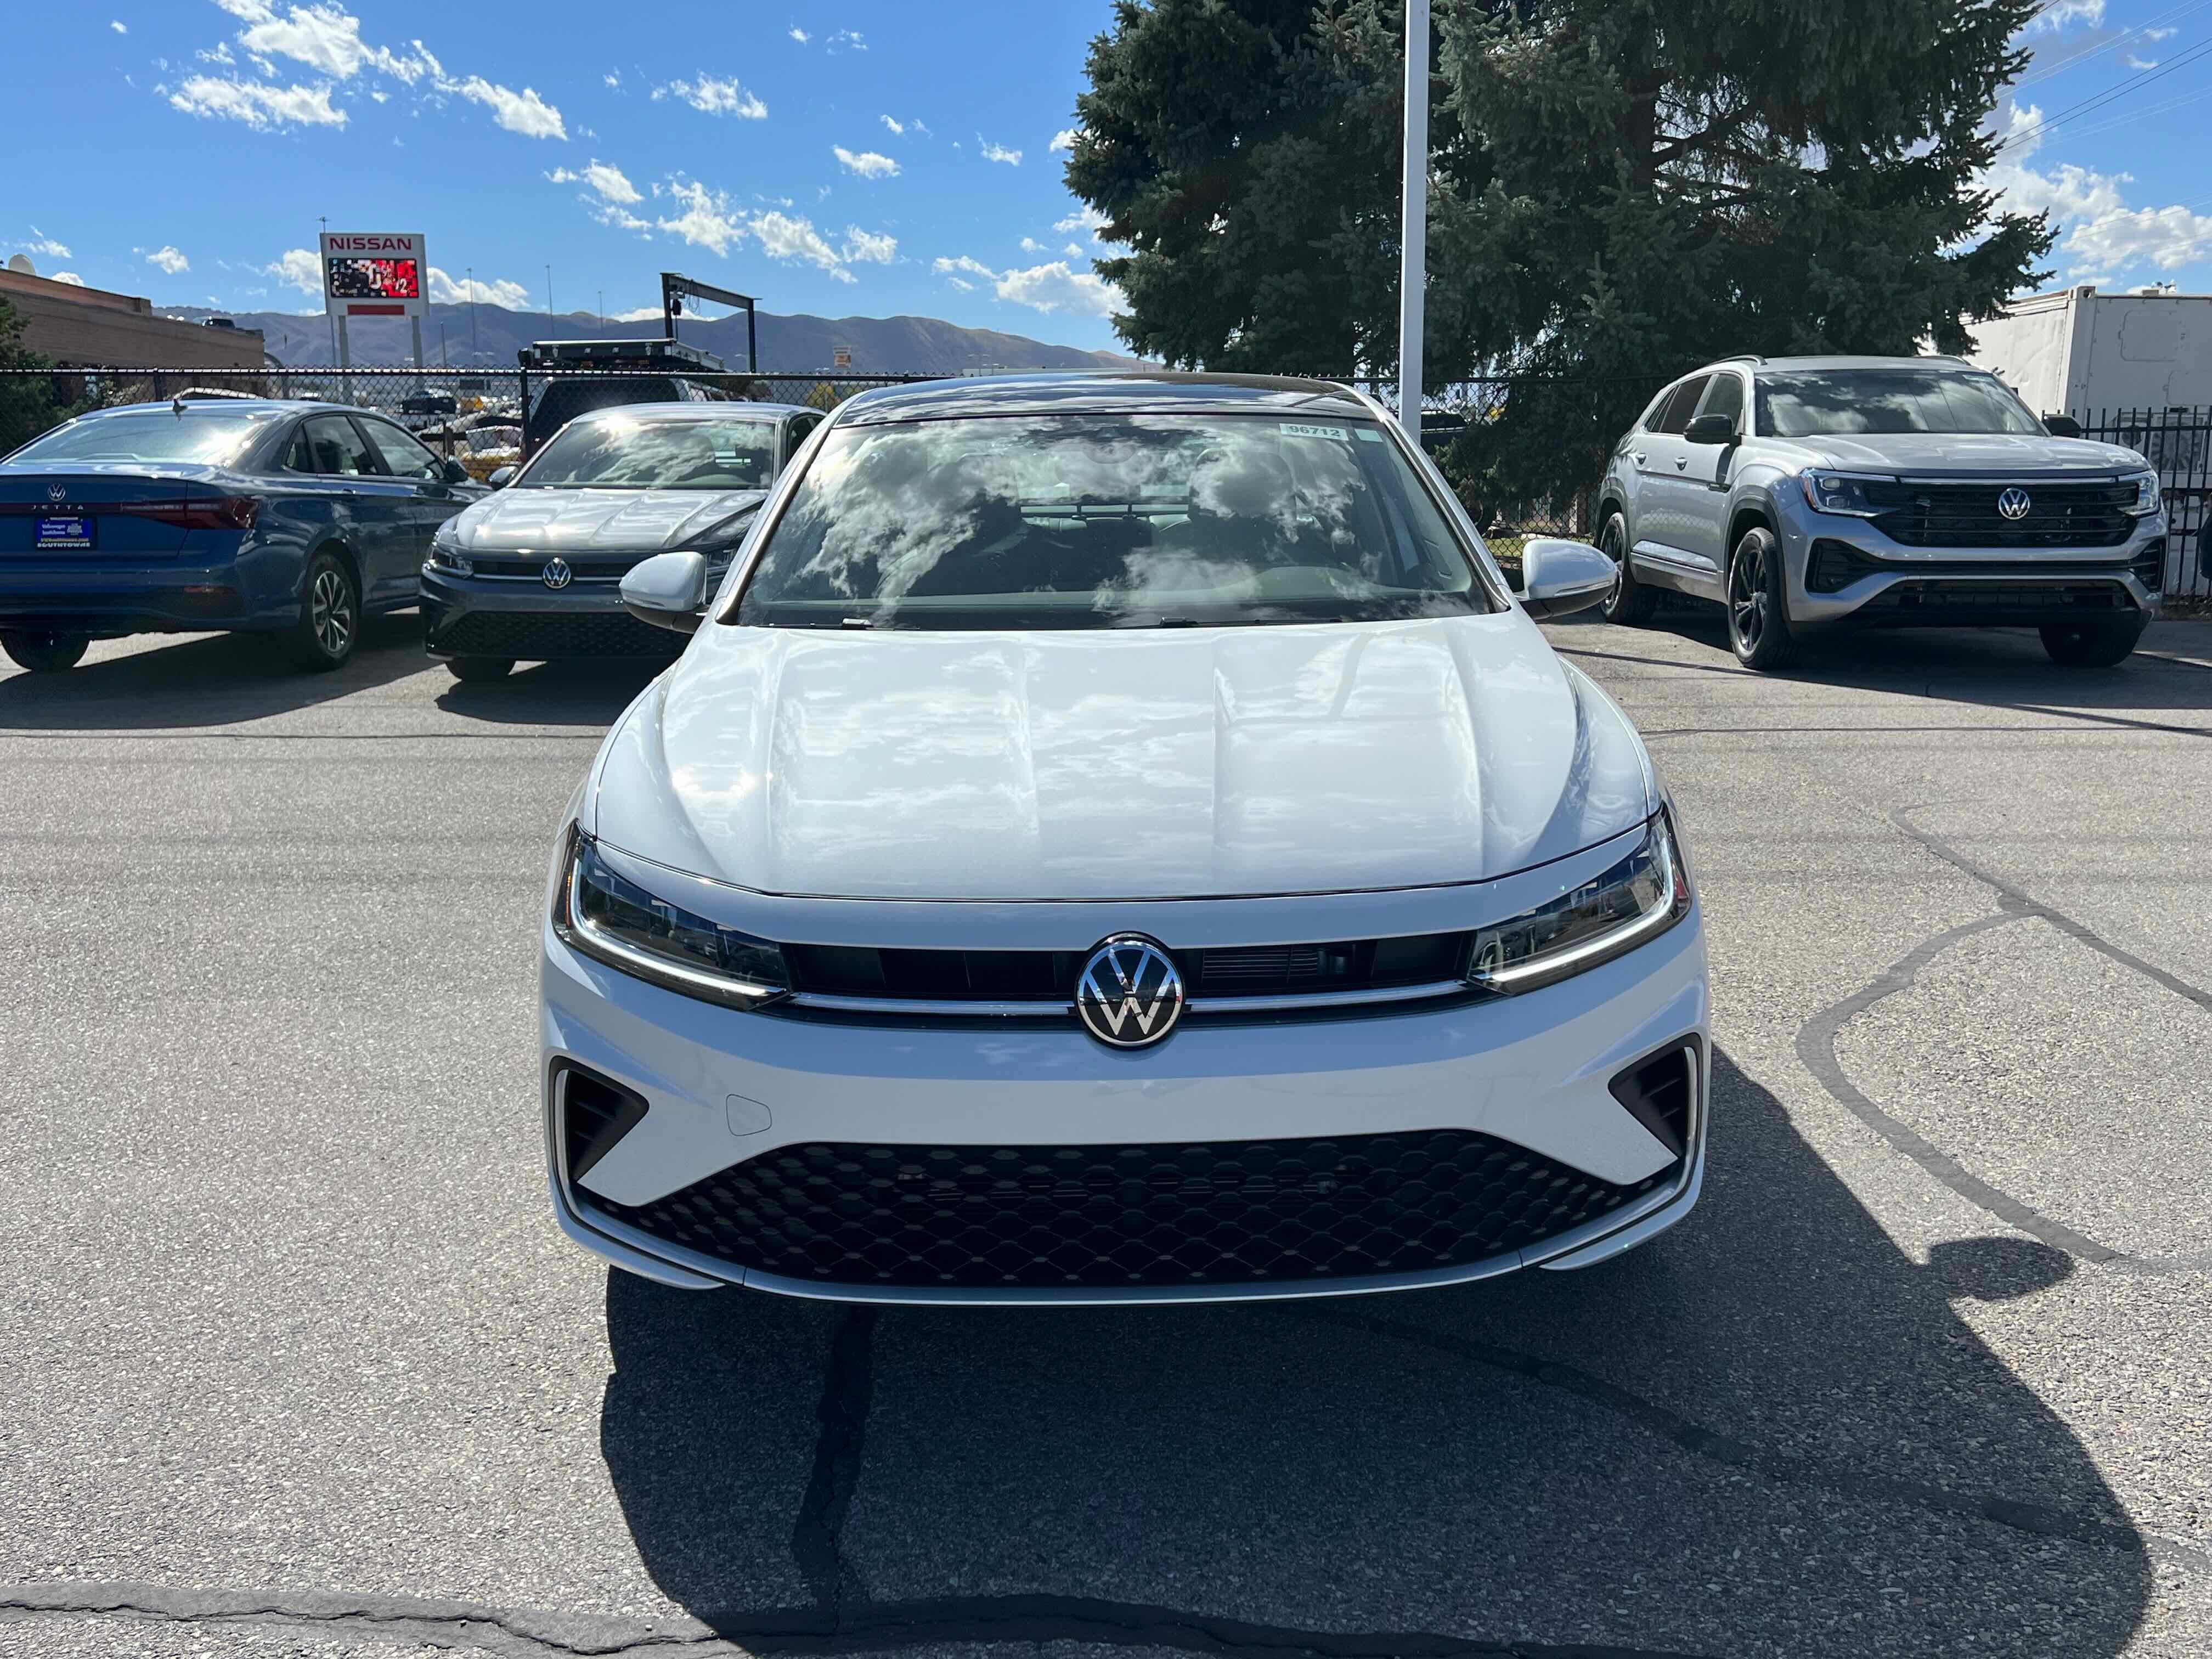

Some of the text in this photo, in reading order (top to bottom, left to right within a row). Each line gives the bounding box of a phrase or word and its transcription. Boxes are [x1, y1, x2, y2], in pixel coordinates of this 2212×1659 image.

[329, 237, 411, 251] NISSAN
[1289, 425, 1341, 437] 96712
[48, 483, 65, 501] VW
[1999, 488, 2030, 520] VW
[543, 557, 571, 588] VW
[1077, 940, 1182, 1047] VW
